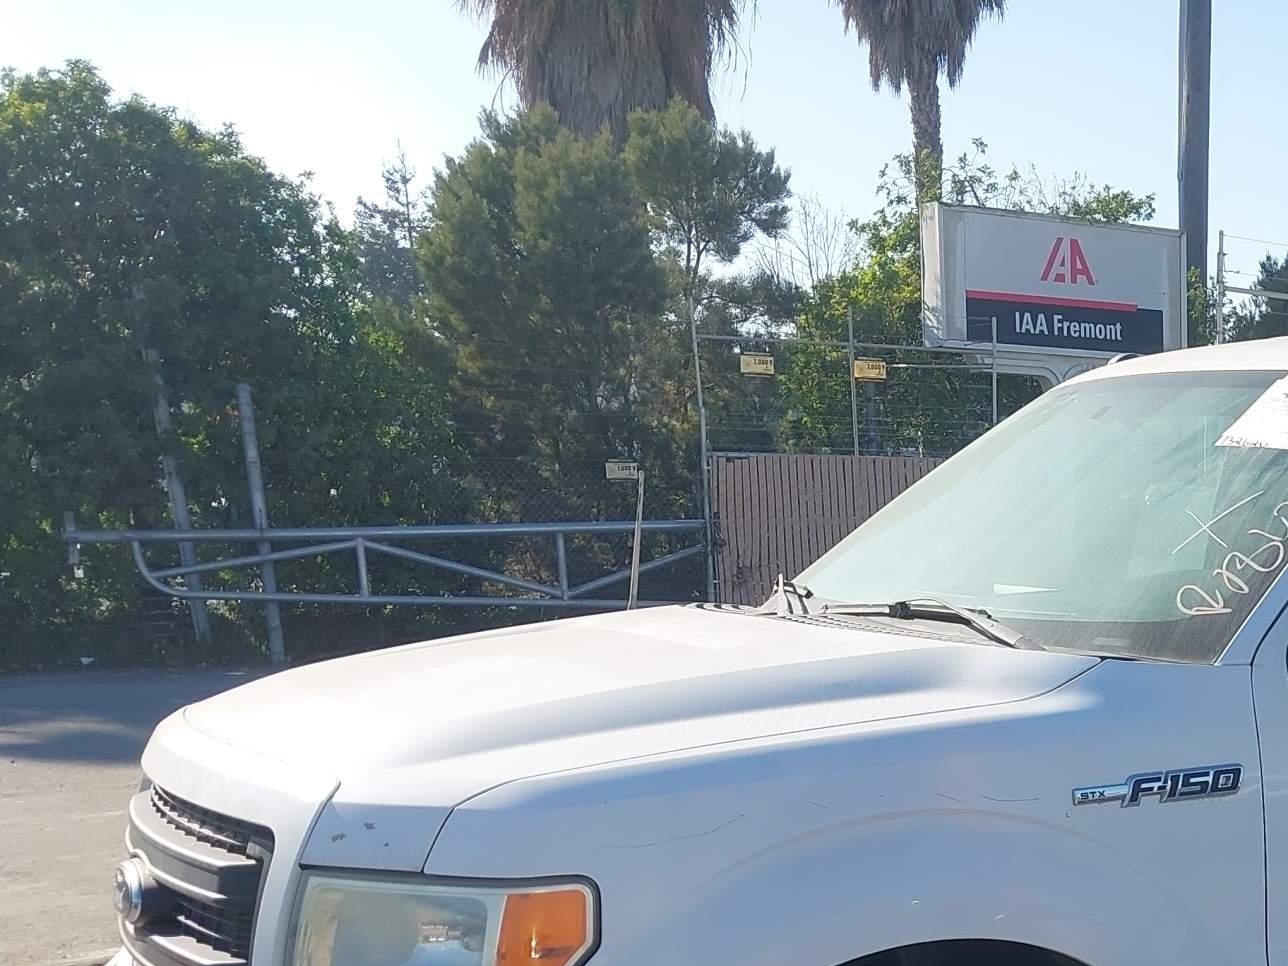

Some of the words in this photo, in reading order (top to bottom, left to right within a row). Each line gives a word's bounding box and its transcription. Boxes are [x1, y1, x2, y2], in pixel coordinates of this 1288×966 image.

[1015, 311, 1049, 335] IAA
[1053, 314, 1122, 341] Fremont
[1079, 789, 1107, 800] STX
[1127, 766, 1244, 804] F-150
